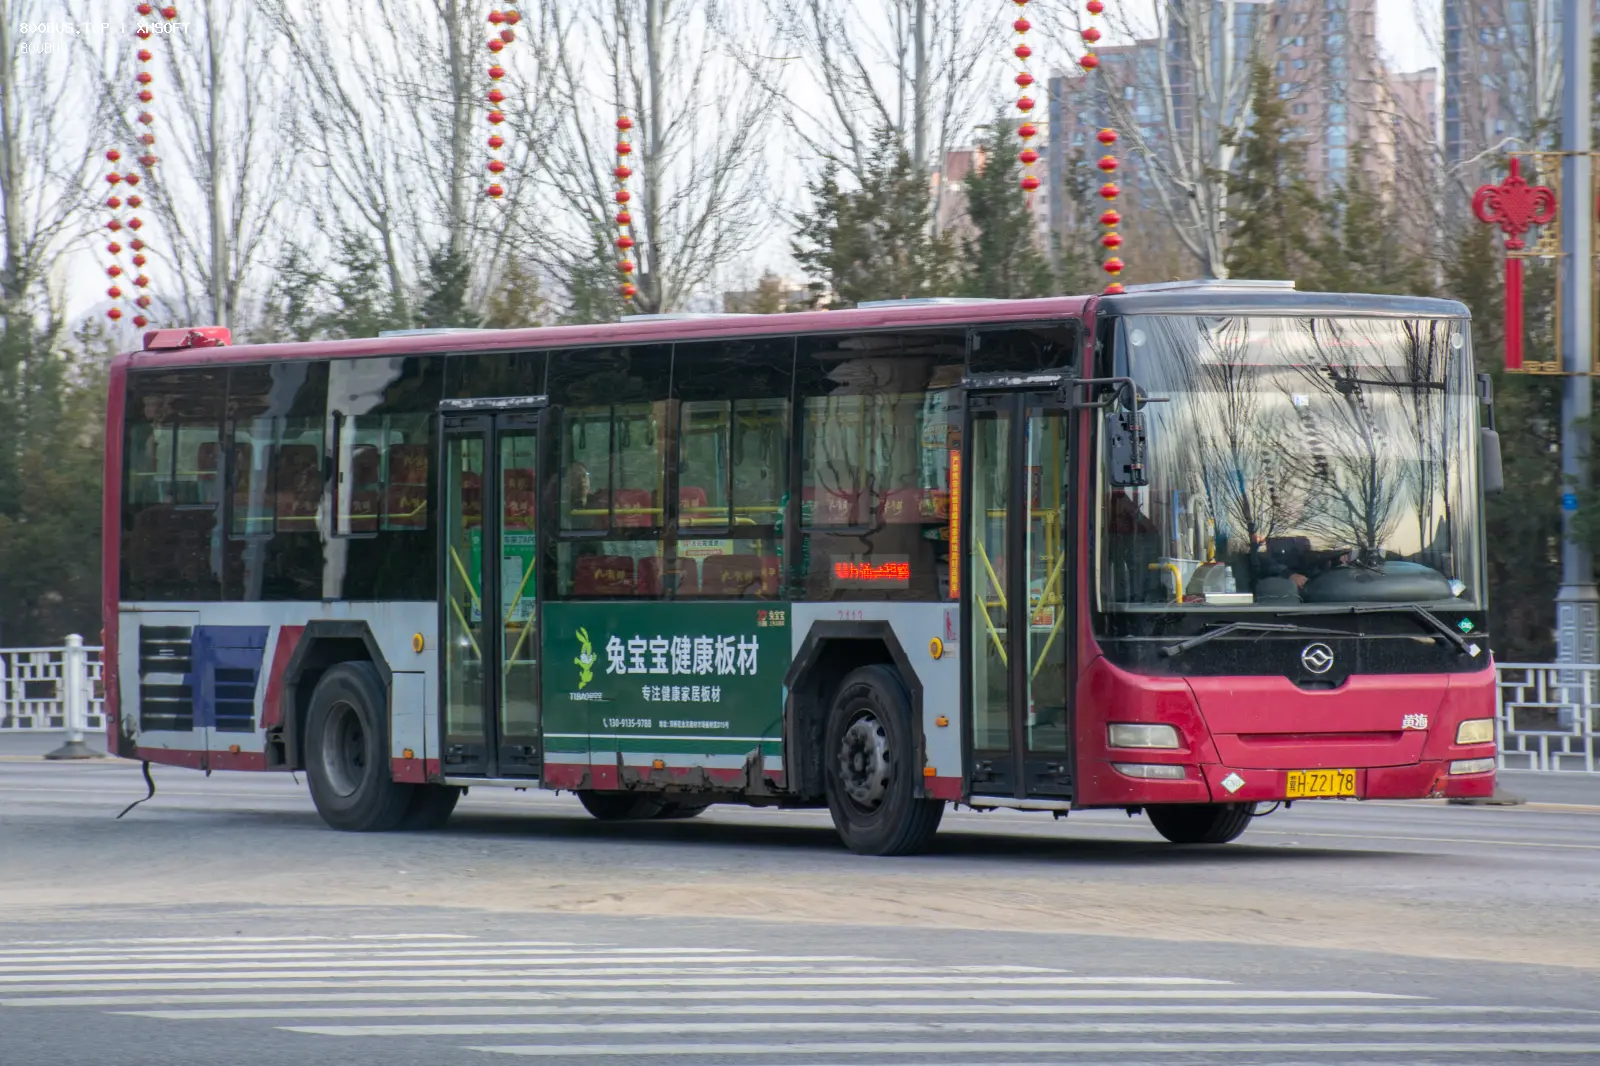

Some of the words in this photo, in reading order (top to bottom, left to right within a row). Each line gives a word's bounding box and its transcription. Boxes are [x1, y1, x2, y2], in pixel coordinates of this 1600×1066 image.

[605, 635, 759, 675] 兔宝宝健康板材
[641, 685, 721, 702] 专注健康家居板材
[1402, 713, 1428, 729] 黄海
